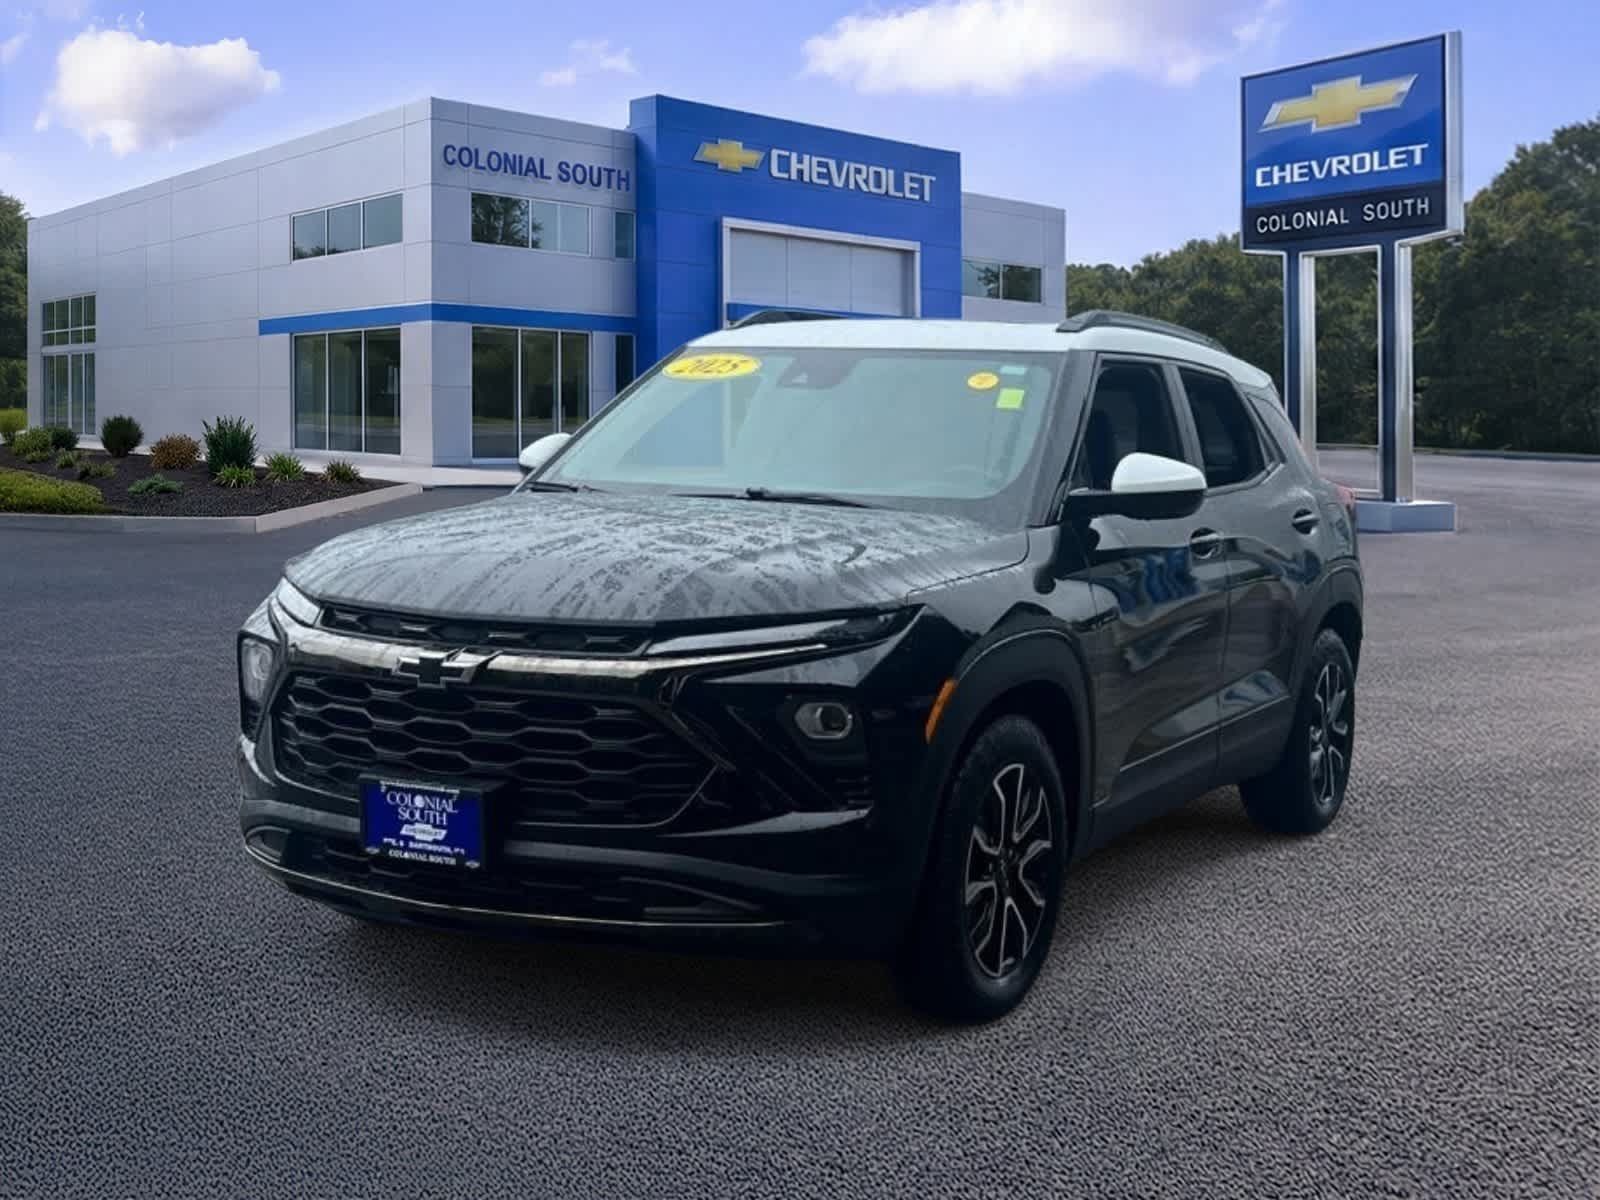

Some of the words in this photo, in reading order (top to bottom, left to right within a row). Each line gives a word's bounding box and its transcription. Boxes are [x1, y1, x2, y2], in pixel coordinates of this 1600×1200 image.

[443, 144, 552, 180] COLONIAL
[557, 161, 631, 192] SOUTH
[770, 148, 936, 202] CHEVROLET
[1255, 143, 1429, 187] CHEVROLET
[1256, 207, 1349, 234] COLONIAL
[1362, 197, 1430, 222] SOUTH
[398, 806, 447, 826] SOUTH
